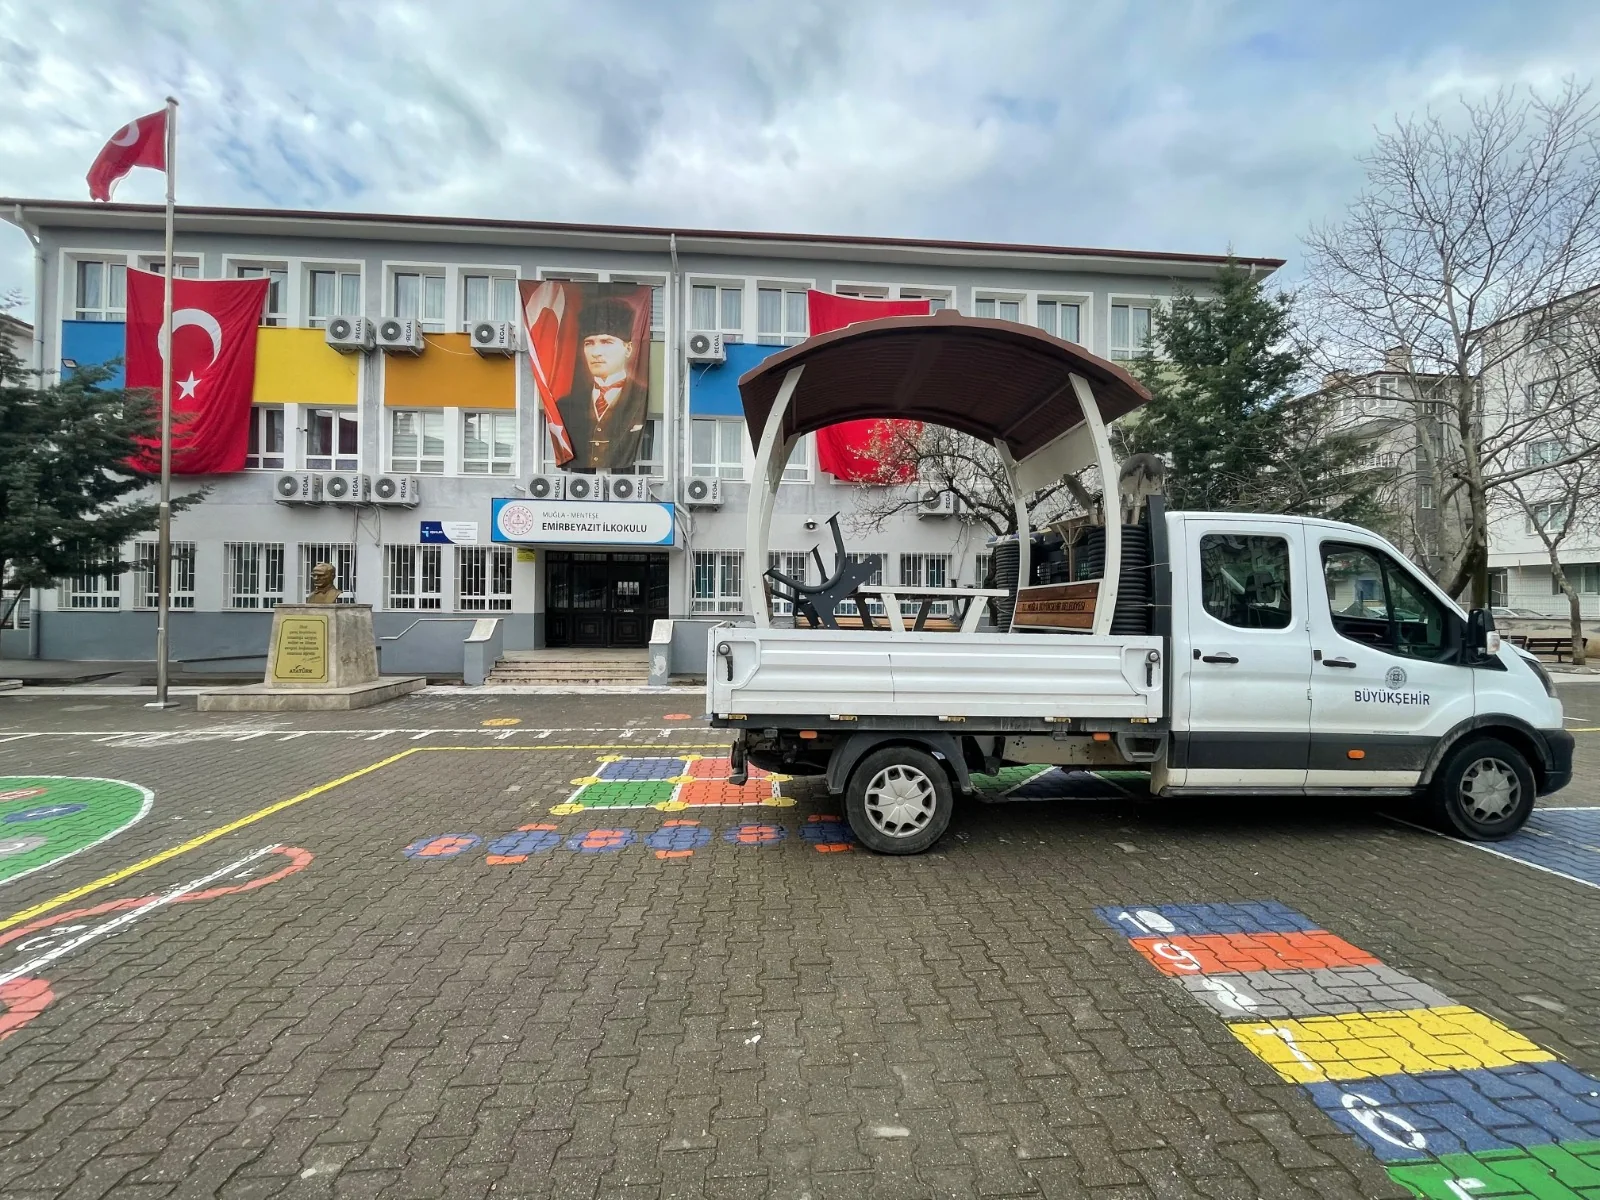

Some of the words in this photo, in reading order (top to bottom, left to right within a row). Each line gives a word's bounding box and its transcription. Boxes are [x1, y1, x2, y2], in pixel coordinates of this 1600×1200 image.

[541, 521, 602, 532] EMİRBEYAZIT
[603, 521, 648, 533] İLKOKULU
[542, 510, 566, 519] MUĞLA
[570, 512, 599, 520] MENTEŞE
[1354, 688, 1430, 706] BÜYÜKŞEHİR
[1118, 910, 1177, 934] 10
[1154, 941, 1202, 971] 9
[1201, 978, 1259, 1012] 8
[1254, 1027, 1317, 1072] 7
[1341, 1092, 1427, 1151] 6
